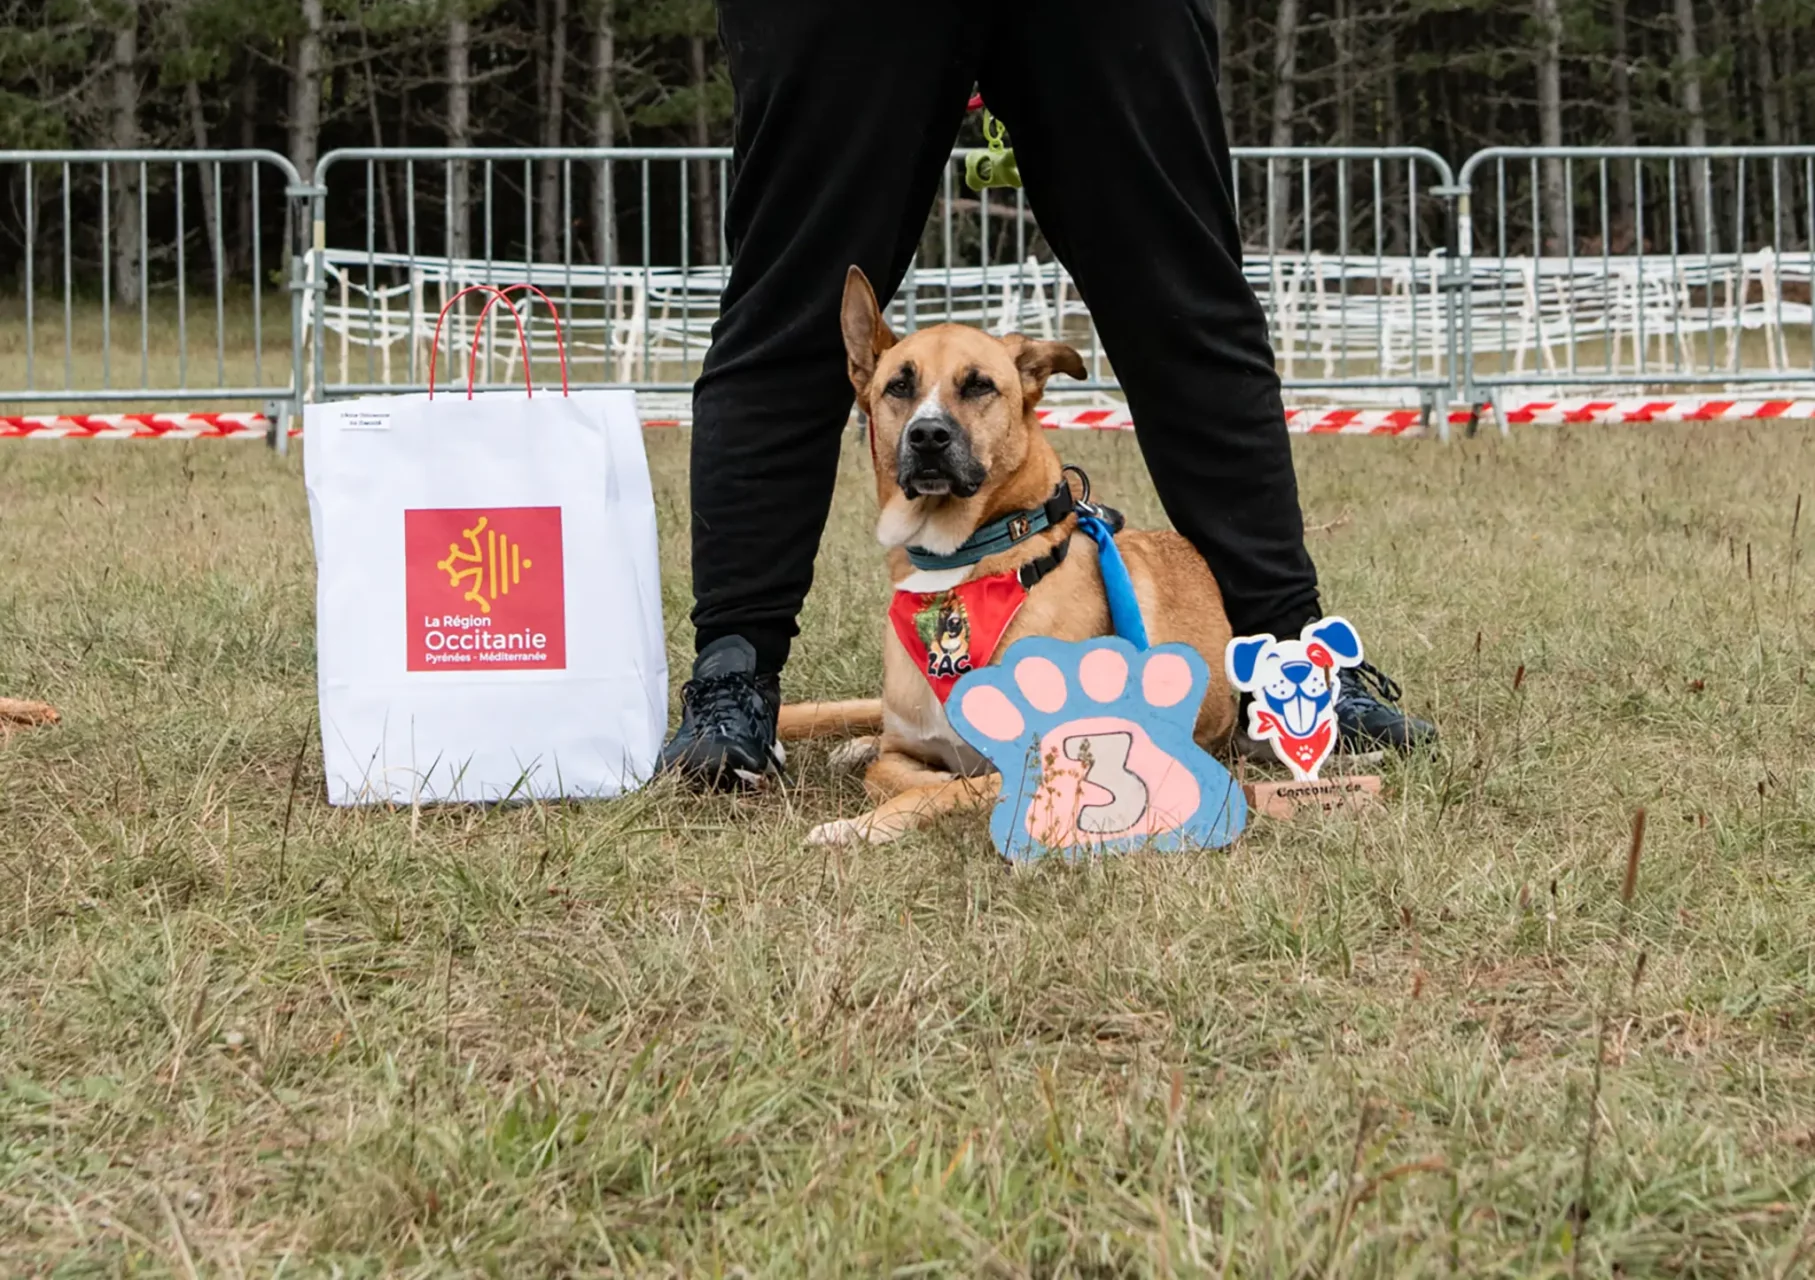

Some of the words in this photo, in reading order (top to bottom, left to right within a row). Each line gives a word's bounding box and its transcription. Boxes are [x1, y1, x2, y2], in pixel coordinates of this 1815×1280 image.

[424, 616, 440, 628] La
[443, 615, 491, 629] Région
[425, 628, 547, 651] Occitanie
[425, 653, 471, 664] Pyrénées
[479, 652, 547, 662] Méditerranée
[1063, 731, 1149, 834] 3
